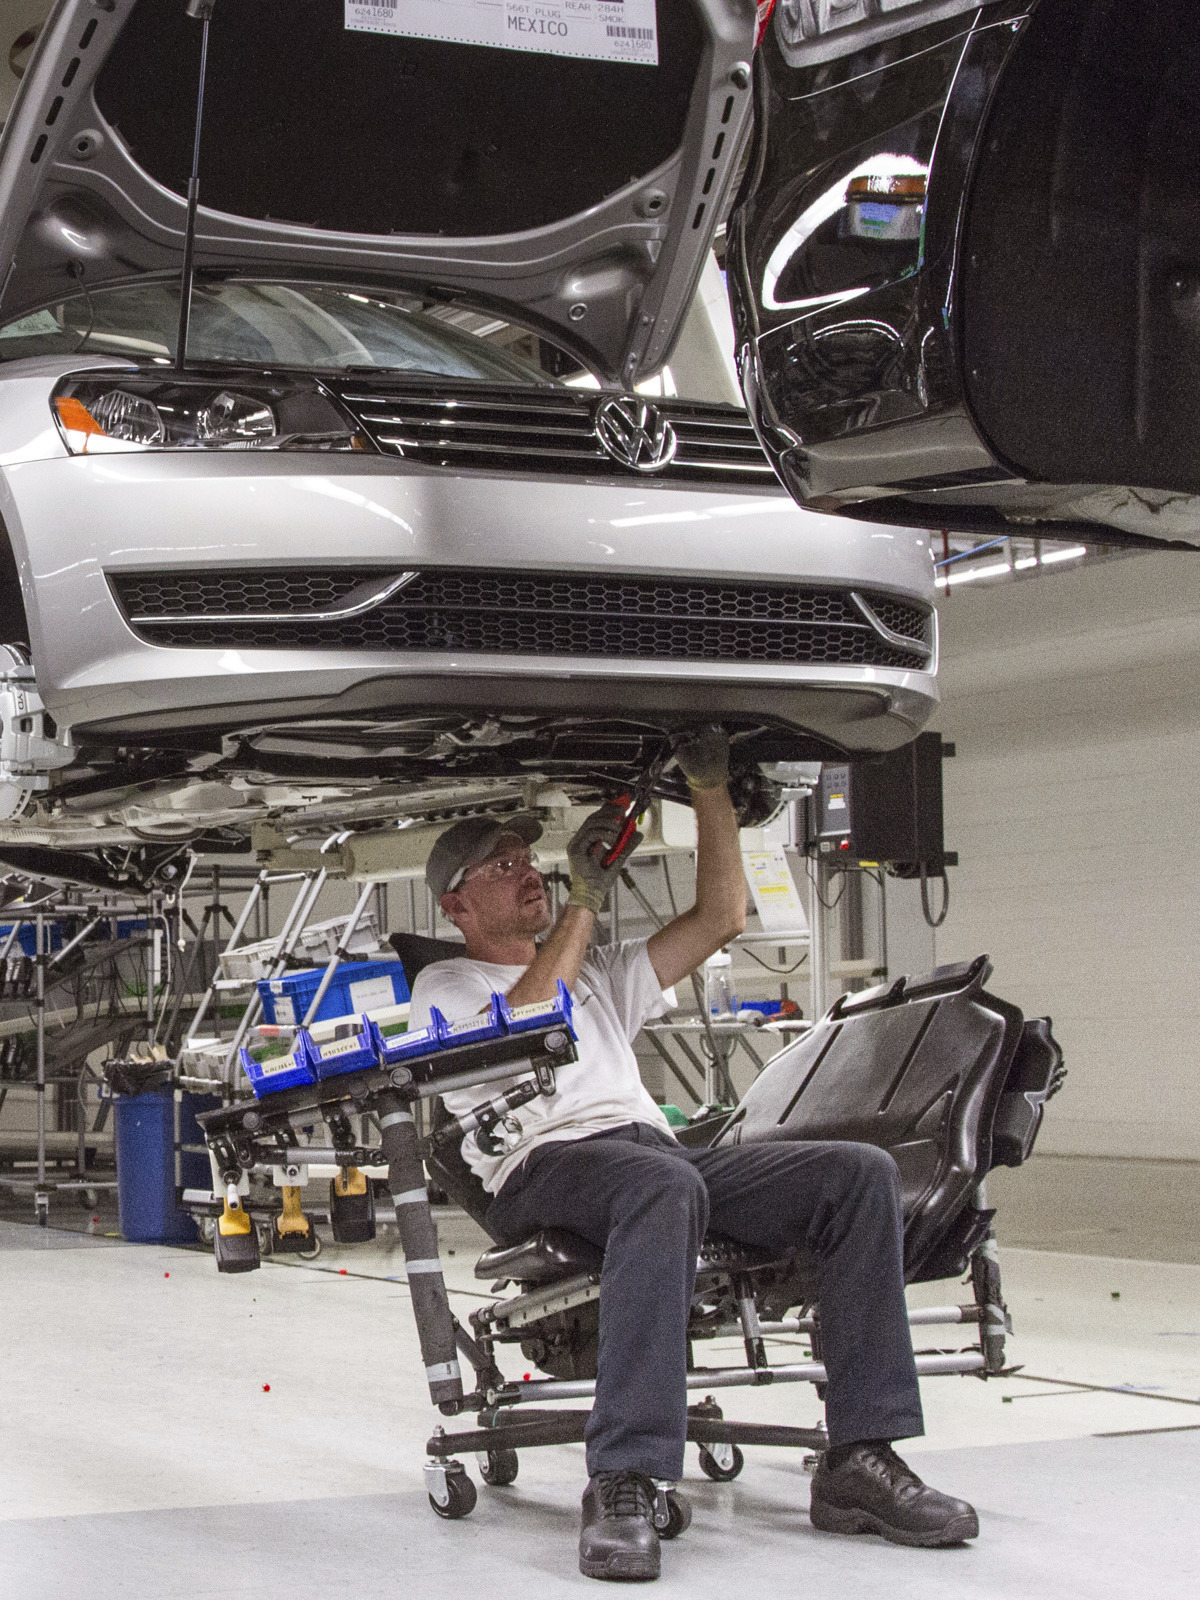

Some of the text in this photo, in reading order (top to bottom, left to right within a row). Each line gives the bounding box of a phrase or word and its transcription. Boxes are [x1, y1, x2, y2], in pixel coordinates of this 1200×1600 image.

[354, 7, 394, 18] 6241680
[535, 7, 561, 19] PLUG
[507, 15, 568, 36] MEXICO
